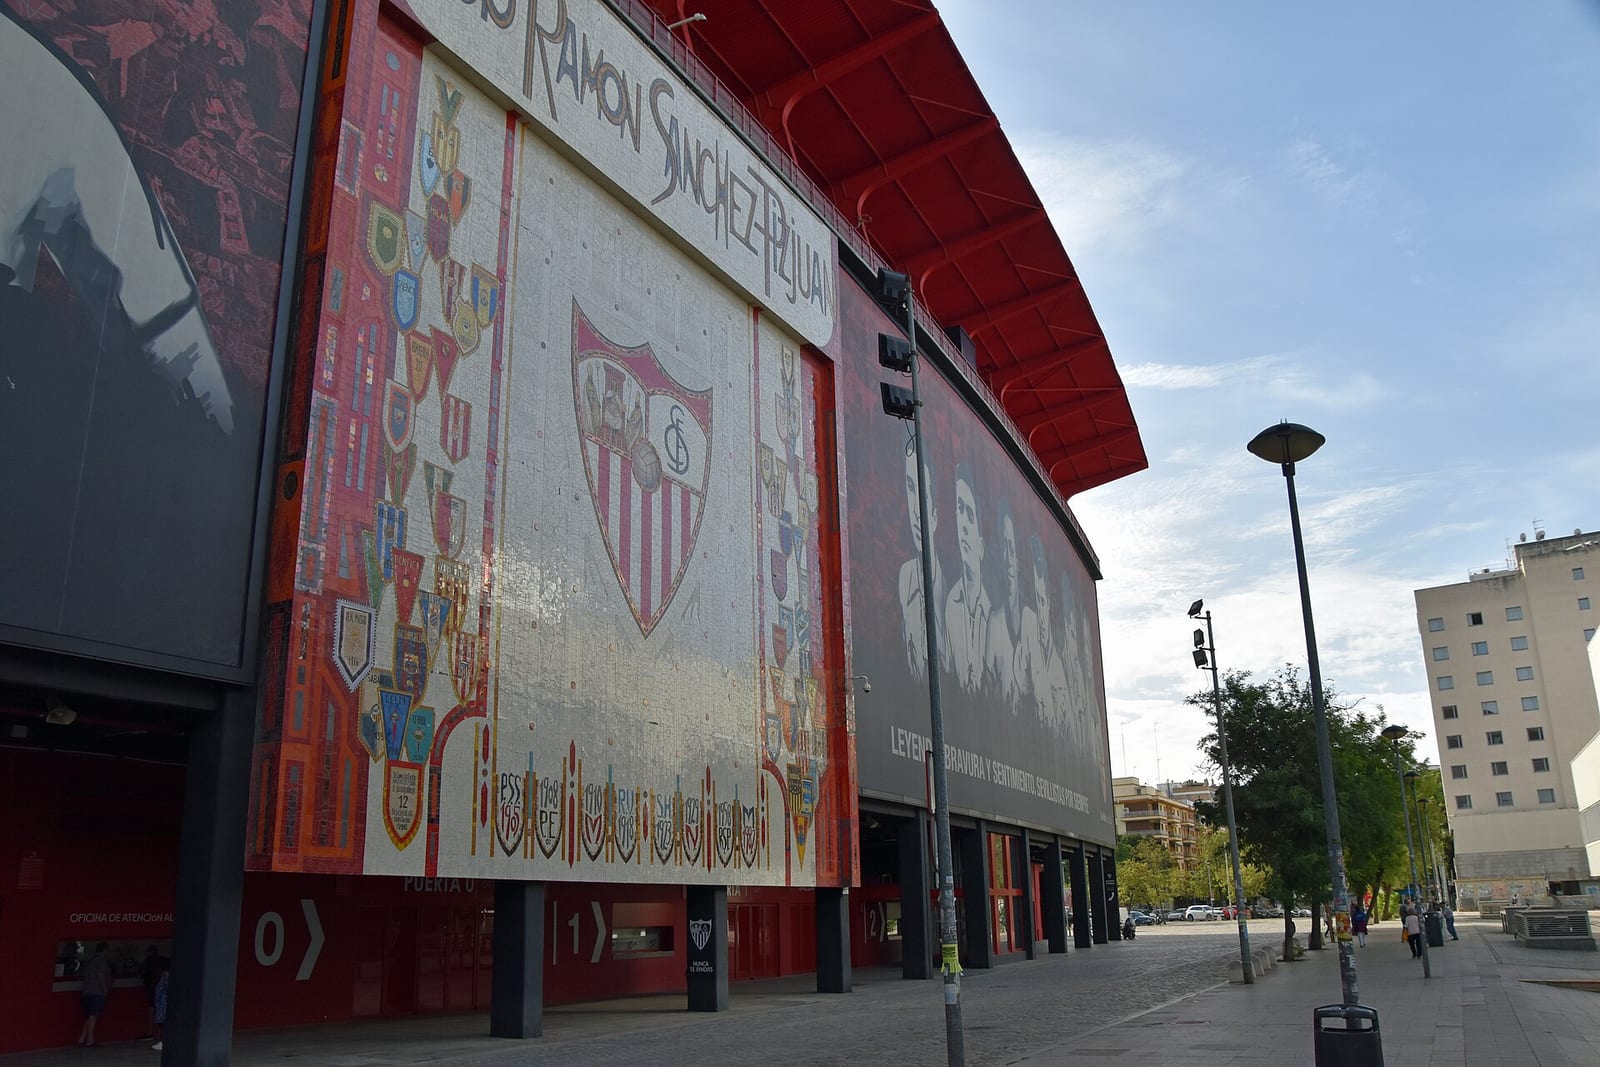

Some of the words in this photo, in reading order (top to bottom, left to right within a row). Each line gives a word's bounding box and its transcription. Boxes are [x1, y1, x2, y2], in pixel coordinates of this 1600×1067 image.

[945, 743, 986, 781] BRAVURA
[985, 758, 992, 781] Y
[398, 795, 409, 809] 12
[541, 777, 558, 809] 1908
[585, 783, 602, 815] 1910
[618, 815, 634, 849] 1918
[685, 824, 699, 850] N
[404, 876, 461, 892] PUERTA
[69, 913, 107, 923] OFICINA
[108, 913, 121, 922] DE
[568, 912, 580, 955] 1
[870, 909, 877, 937] 2
[254, 911, 285, 967] 0
